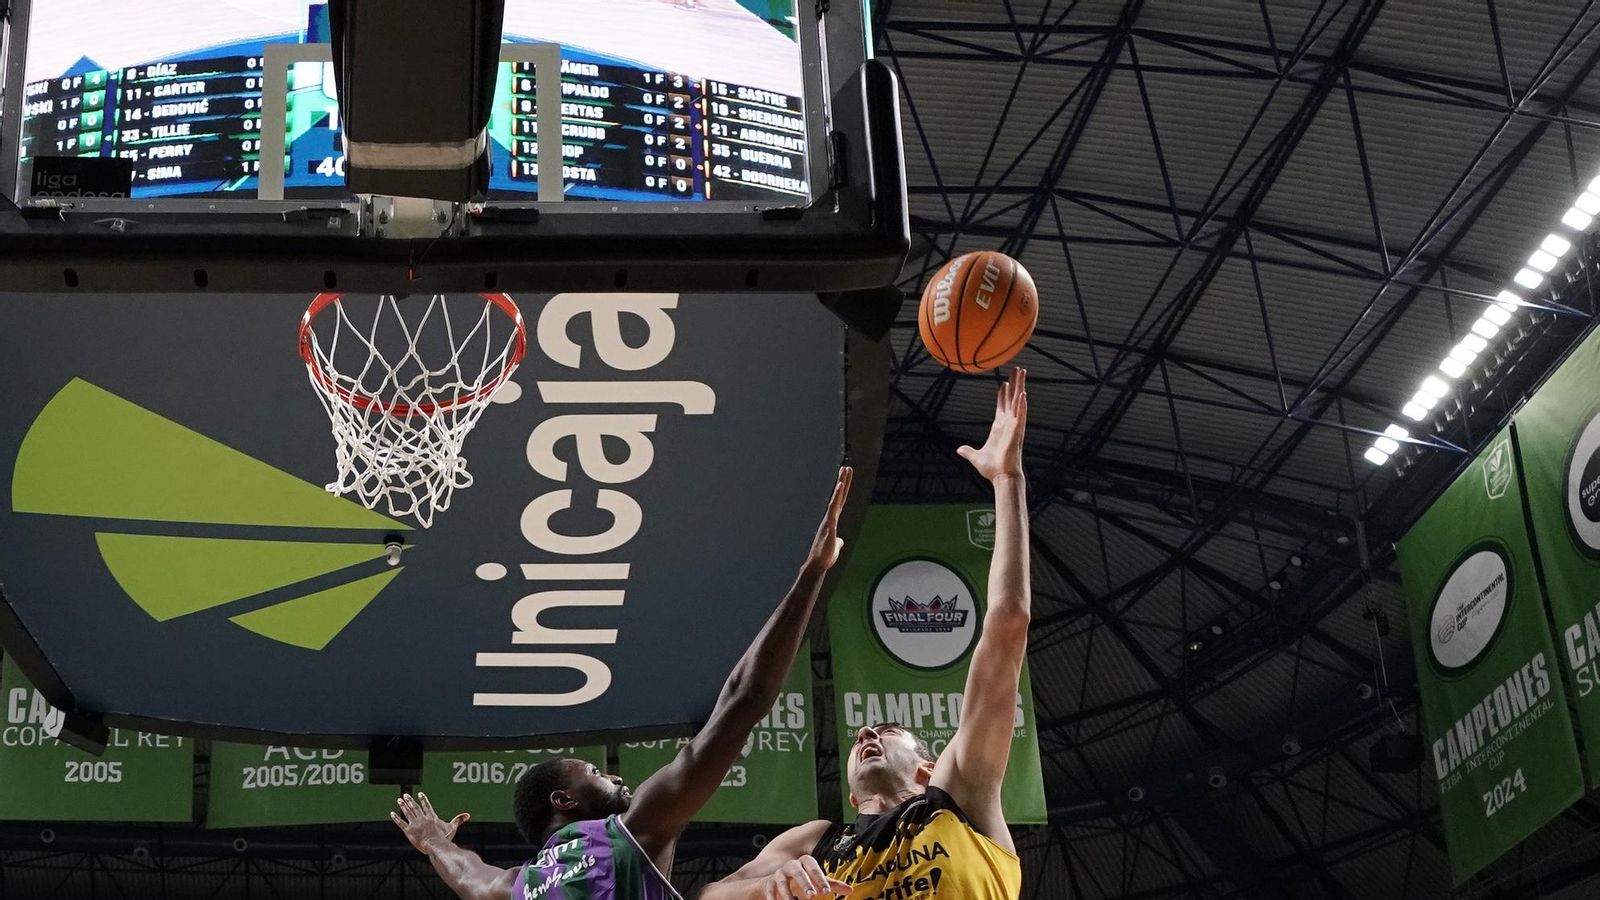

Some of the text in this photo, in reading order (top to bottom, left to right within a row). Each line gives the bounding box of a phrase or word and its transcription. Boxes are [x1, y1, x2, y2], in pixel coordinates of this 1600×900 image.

[560, 60, 599, 76] ÄMER
[673, 76, 683, 88] 3
[561, 83, 609, 98] IPALDO
[738, 87, 787, 108] SASTRE
[674, 97, 684, 108] 2
[561, 103, 604, 119] ERTAS
[151, 124, 191, 138] TILLIE
[674, 118, 685, 129] 2
[711, 123, 728, 136] 21
[562, 124, 606, 140] CRUBB
[149, 144, 194, 159] PERRY
[562, 145, 584, 158] IOP
[675, 138, 686, 150] 2
[147, 166, 183, 181] SIMA
[562, 166, 597, 181] OSTA
[713, 165, 732, 178] 42
[473, 293, 717, 706] Unicaja
[885, 612, 964, 622] FINAL FOUR
[1433, 652, 1551, 780] CAMPEONES
[3, 726, 71, 747] COP
[759, 731, 809, 752] REY
[1466, 698, 1555, 776] INTERCONTINENTAL
[64, 761, 122, 783] 2005
[242, 762, 365, 789] 2005/2006
[1482, 767, 1528, 818] 2024
